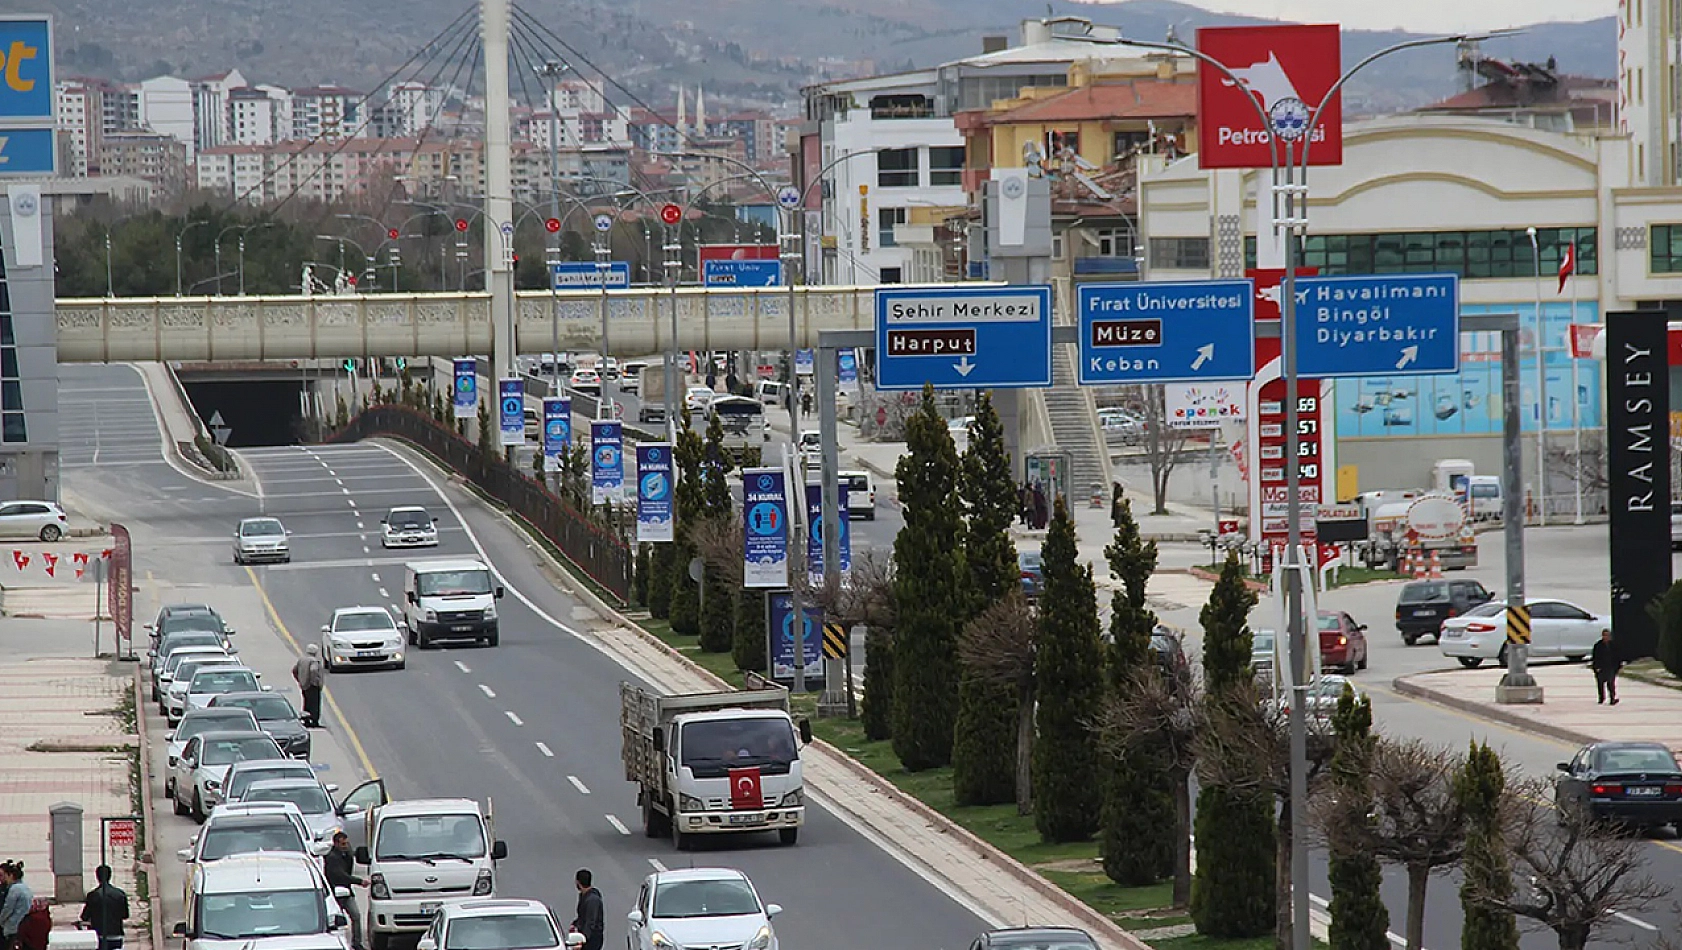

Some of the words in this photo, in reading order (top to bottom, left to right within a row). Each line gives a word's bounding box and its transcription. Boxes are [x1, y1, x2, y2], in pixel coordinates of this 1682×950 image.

[0, 41, 37, 91] t
[1218, 127, 1269, 145] Petro
[1090, 297, 1130, 311] Fırat
[1136, 292, 1241, 311] Üniversitesi
[1317, 285, 1446, 301] Havalimanı
[892, 303, 944, 319] Şehir
[953, 302, 1034, 317] Merkezi
[1317, 305, 1389, 325] Bingöl
[1097, 326, 1157, 341] Müze
[1317, 326, 1438, 348] Diyarbakır
[893, 336, 972, 354] Harput
[1090, 356, 1160, 372] Keban
[1175, 404, 1240, 420] epenek
[1624, 343, 1653, 512] RAMSEY
[758, 492, 785, 502] KURAL
[1263, 487, 1317, 501] Maket
